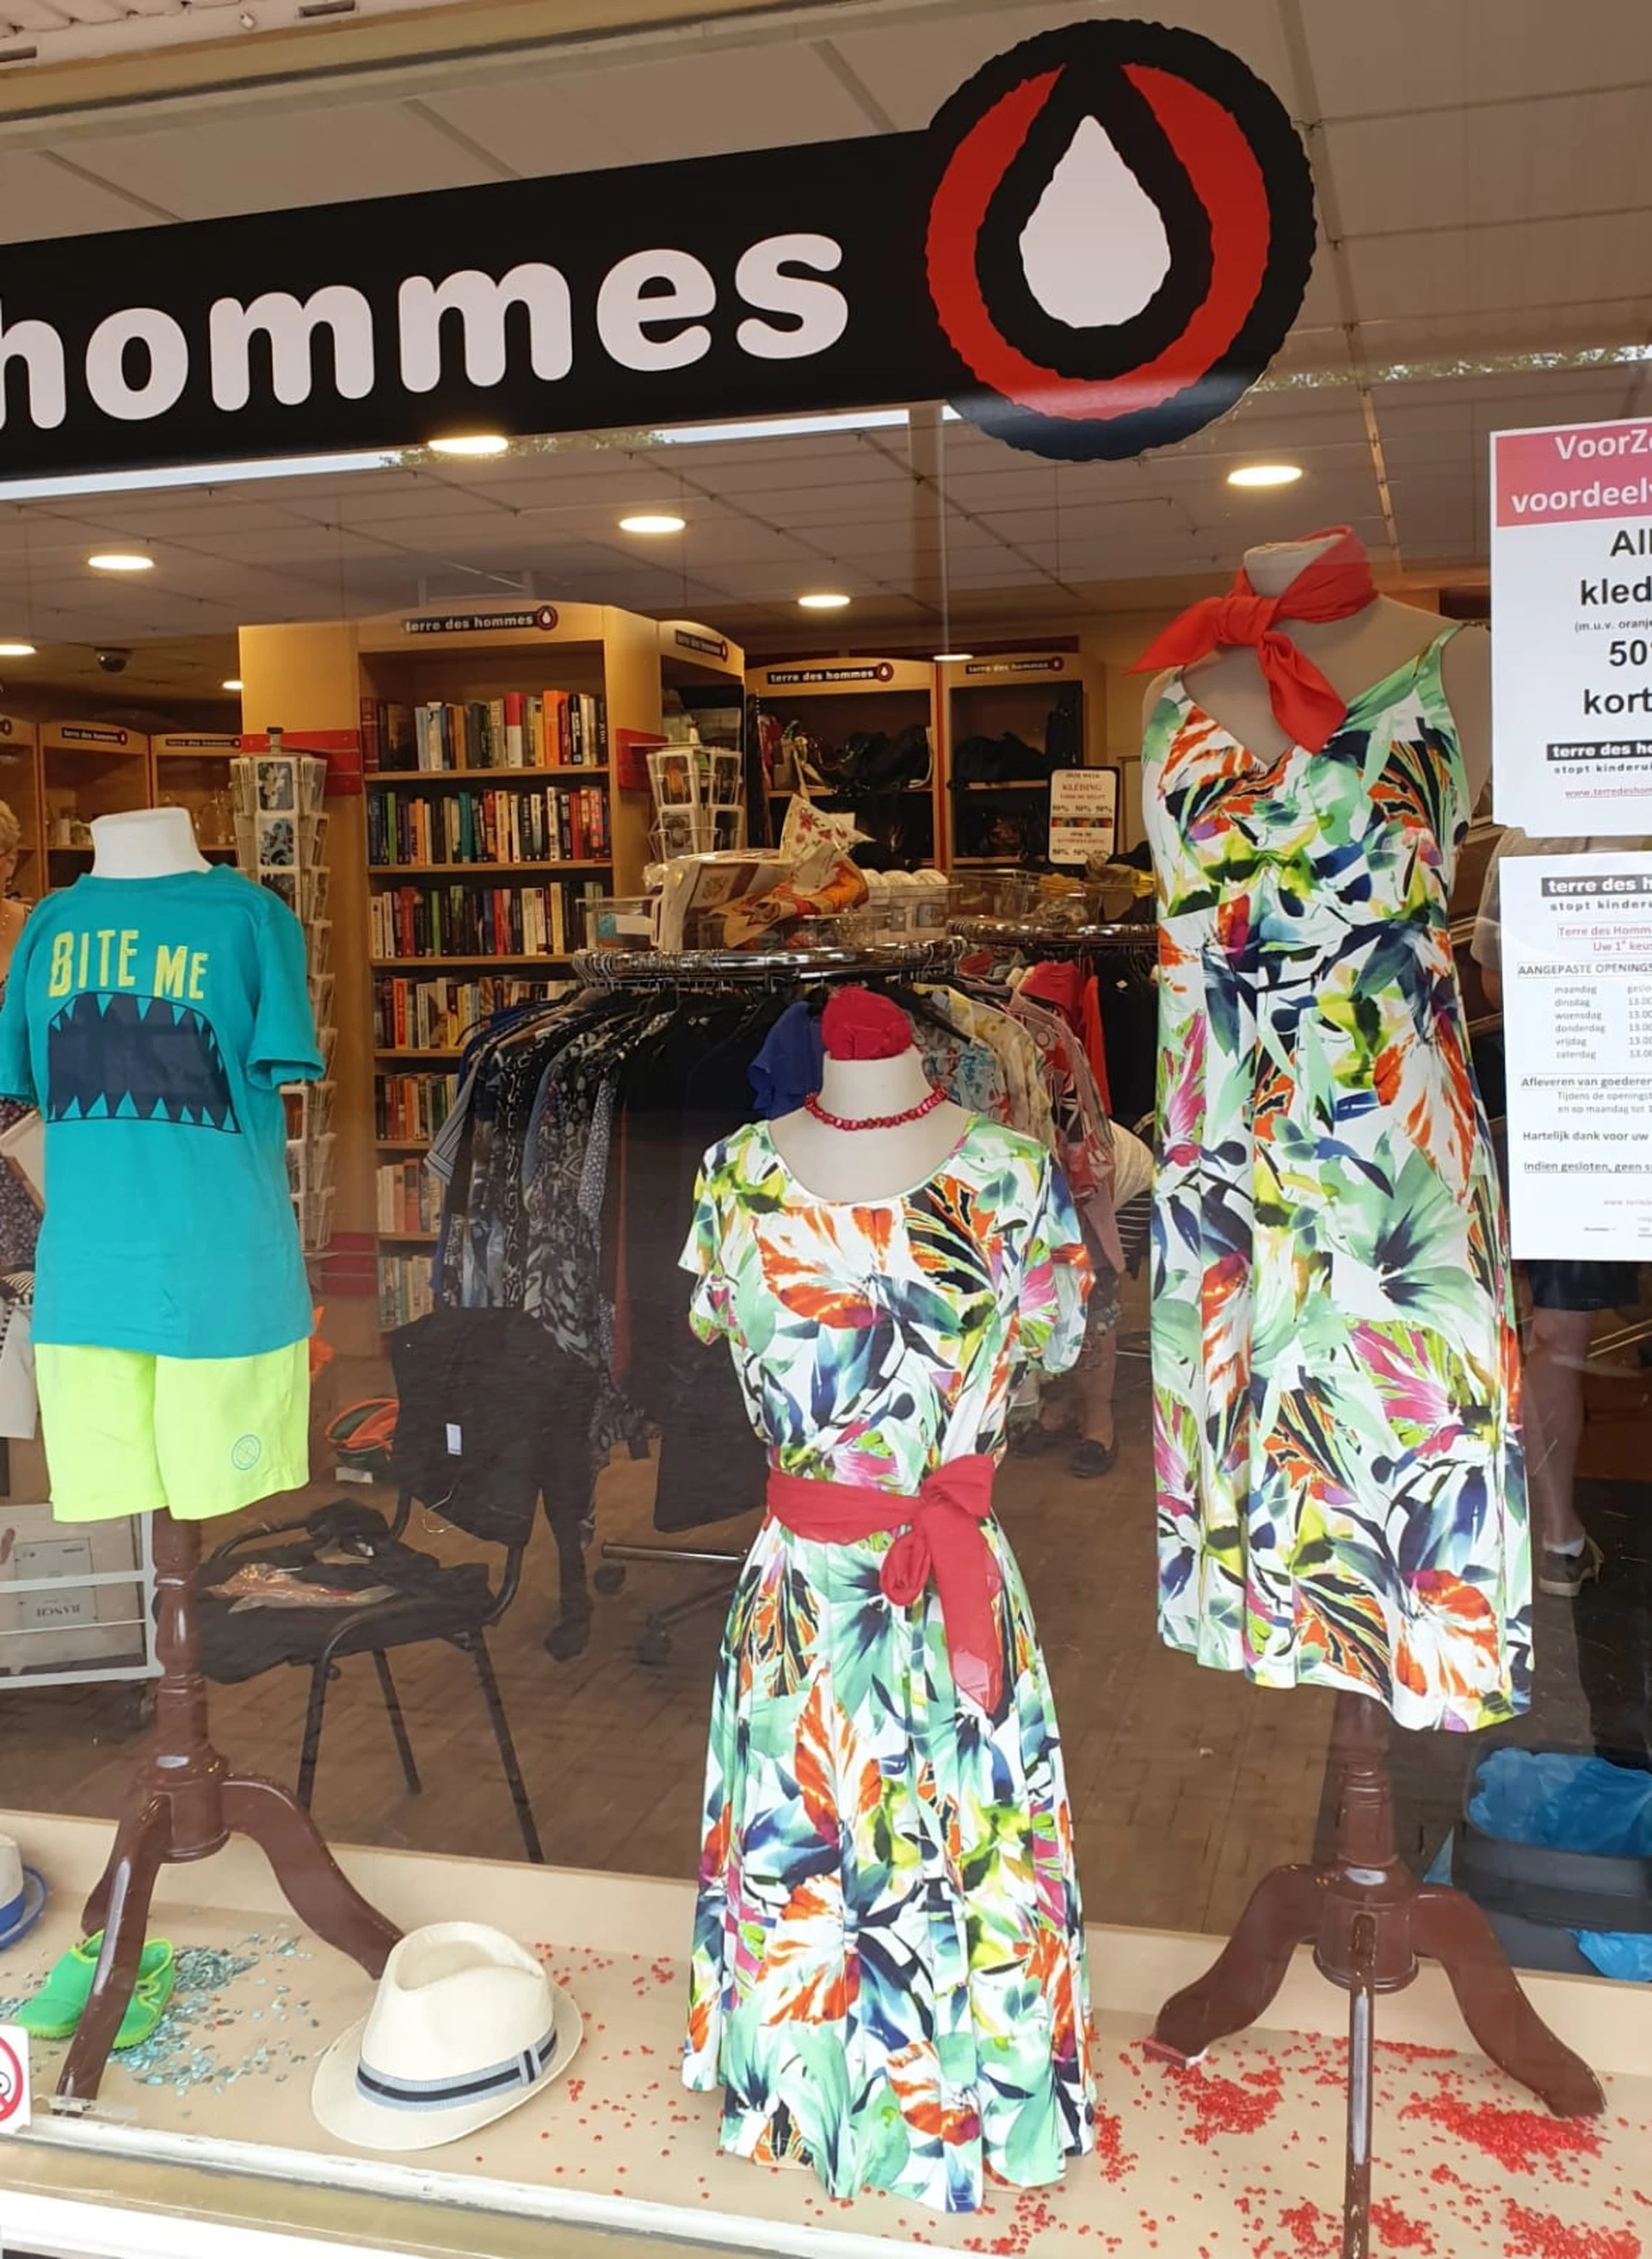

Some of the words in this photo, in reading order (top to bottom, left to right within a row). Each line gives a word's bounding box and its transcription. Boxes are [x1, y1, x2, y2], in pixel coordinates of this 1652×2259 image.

[1555, 429, 1652, 460] VoorZ
[1511, 477, 1652, 513] voordeel
[1581, 575, 1652, 606] kled
[405, 621, 441, 632] terre
[445, 619, 470, 631] des
[474, 615, 533, 628] hommes
[1610, 639, 1652, 667] 50
[771, 674, 799, 682] terre
[803, 671, 823, 682] des
[826, 670, 874, 680] hommes
[1584, 687, 1652, 715] kort
[1552, 745, 1596, 758] terre
[1600, 743, 1631, 756] des
[1554, 765, 1591, 775] stopt
[1548, 880, 1597, 892] terre
[1601, 878, 1636, 892] des
[1550, 900, 1590, 912] stopt
[1559, 926, 1588, 936] Terre
[1591, 926, 1611, 935] des
[1593, 941, 1612, 951] Uw
[48, 929, 139, 998] BITE
[152, 945, 209, 1000] ME
[1518, 964, 1593, 975] AANGEPASTE
[1554, 985, 1598, 995] maandag
[1554, 997, 1590, 1008] dinsdag
[1555, 1023, 1606, 1034] donderdag
[1556, 1036, 1587, 1047] vrijdag
[1521, 1077, 1575, 1087] Afleveren
[1523, 1130, 1570, 1143] Hartelijk
[1572, 1130, 1600, 1141] dank
[1602, 1132, 1629, 1141] voor
[1630, 1132, 1649, 1141] uw
[1524, 1161, 1558, 1171] Indien
[1614, 1163, 1643, 1173] geen
